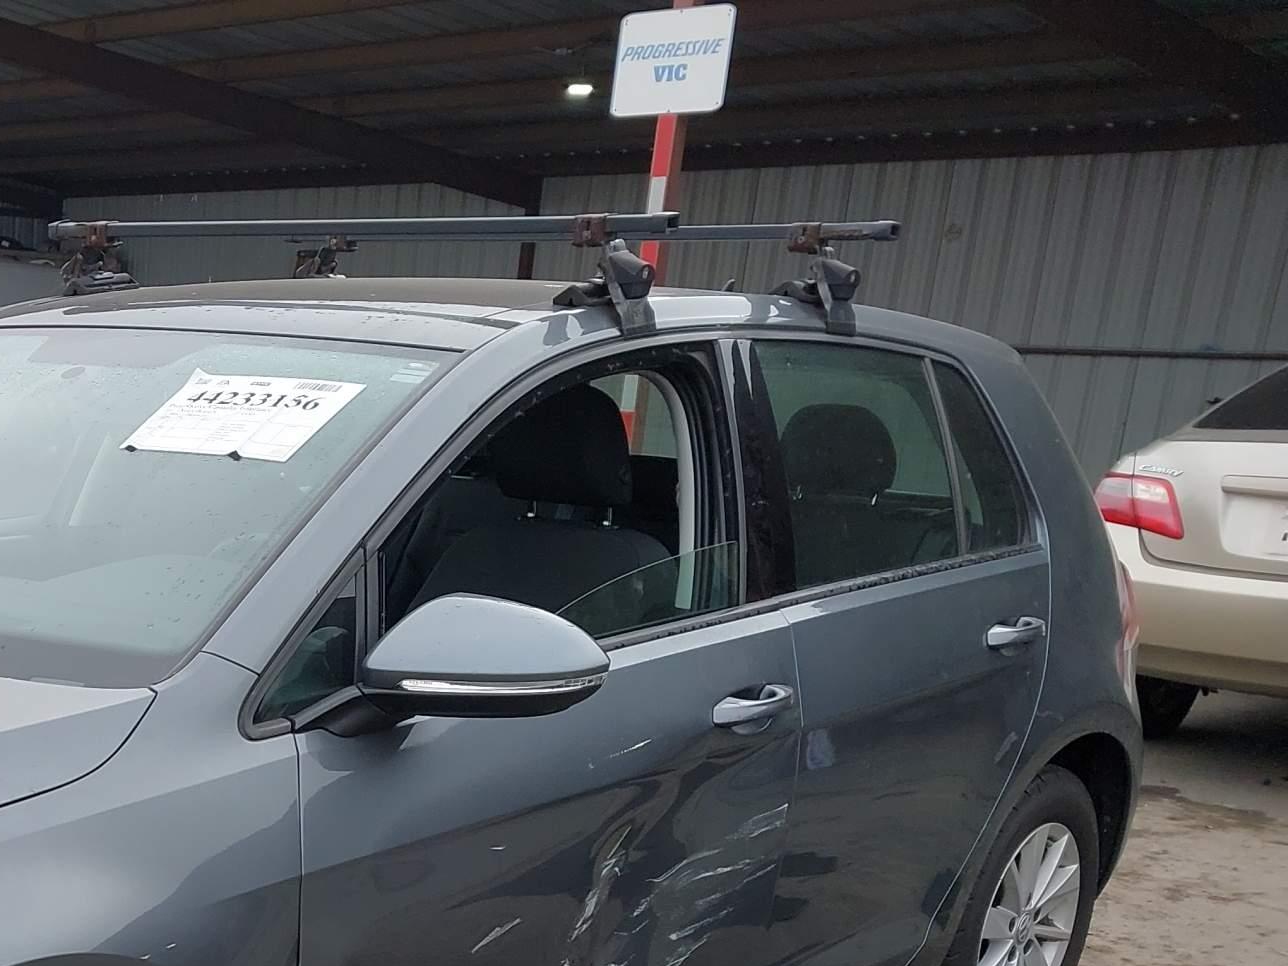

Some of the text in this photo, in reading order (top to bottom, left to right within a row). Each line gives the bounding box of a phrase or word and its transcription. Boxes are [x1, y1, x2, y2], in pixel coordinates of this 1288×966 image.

[621, 38, 726, 63] PROGRESSIVE
[653, 63, 688, 83] VIC
[187, 390, 326, 410] 44233156
